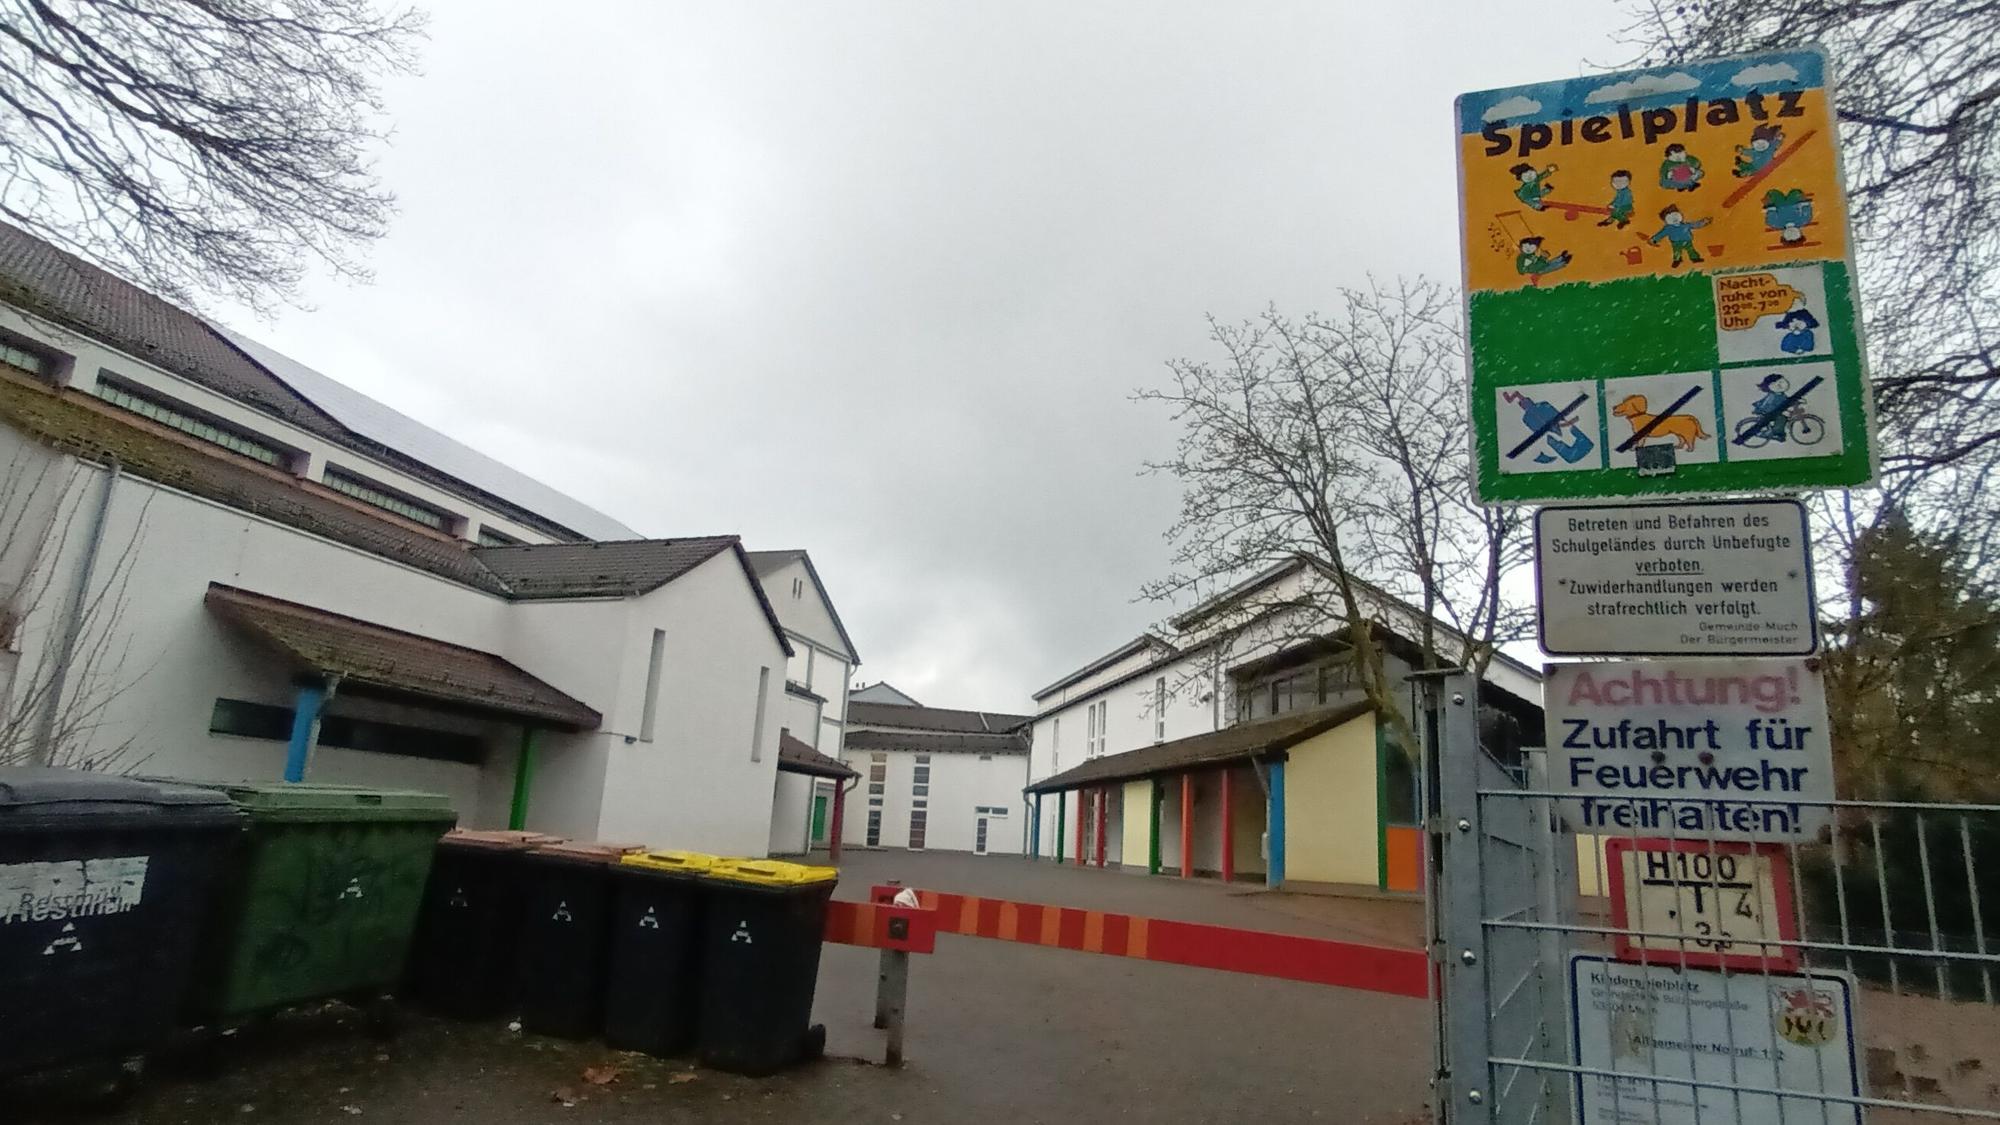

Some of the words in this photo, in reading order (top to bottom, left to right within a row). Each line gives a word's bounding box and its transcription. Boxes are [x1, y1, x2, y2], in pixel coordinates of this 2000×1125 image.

[1482, 89, 1805, 157] Spielplatz
[1720, 277, 1770, 290] Nacht-
[1721, 291, 1754, 302] ruhe
[1760, 288, 1788, 299] von
[1723, 316, 1750, 328] Uhr
[1568, 517, 1628, 532] Betreten
[1635, 515, 1661, 530] und
[1668, 514, 1735, 529] Befahren
[1743, 514, 1769, 528] des
[1552, 536, 1656, 555] Schulgeländes
[1664, 536, 1705, 551] durch
[1712, 535, 1791, 552] Unbefugte
[1635, 558, 1705, 573] verboten.
[1569, 579, 1713, 597] Zuwiderhandlungen
[1720, 578, 1778, 593] werden
[1587, 601, 1688, 616] strafrechtlich
[1696, 600, 1761, 618] verfolgt.
[1699, 621, 1760, 632] Gemeinde
[1766, 621, 1798, 631] Much
[1680, 634, 1701, 645] Der
[1707, 633, 1798, 646] Bürgermeister
[1568, 666, 1801, 713] Achtung!
[1562, 719, 1721, 750] Zufahrt
[1745, 718, 1813, 750] für
[1569, 757, 1809, 792] Feuerwehr
[1581, 796, 1802, 834] freihaten!
